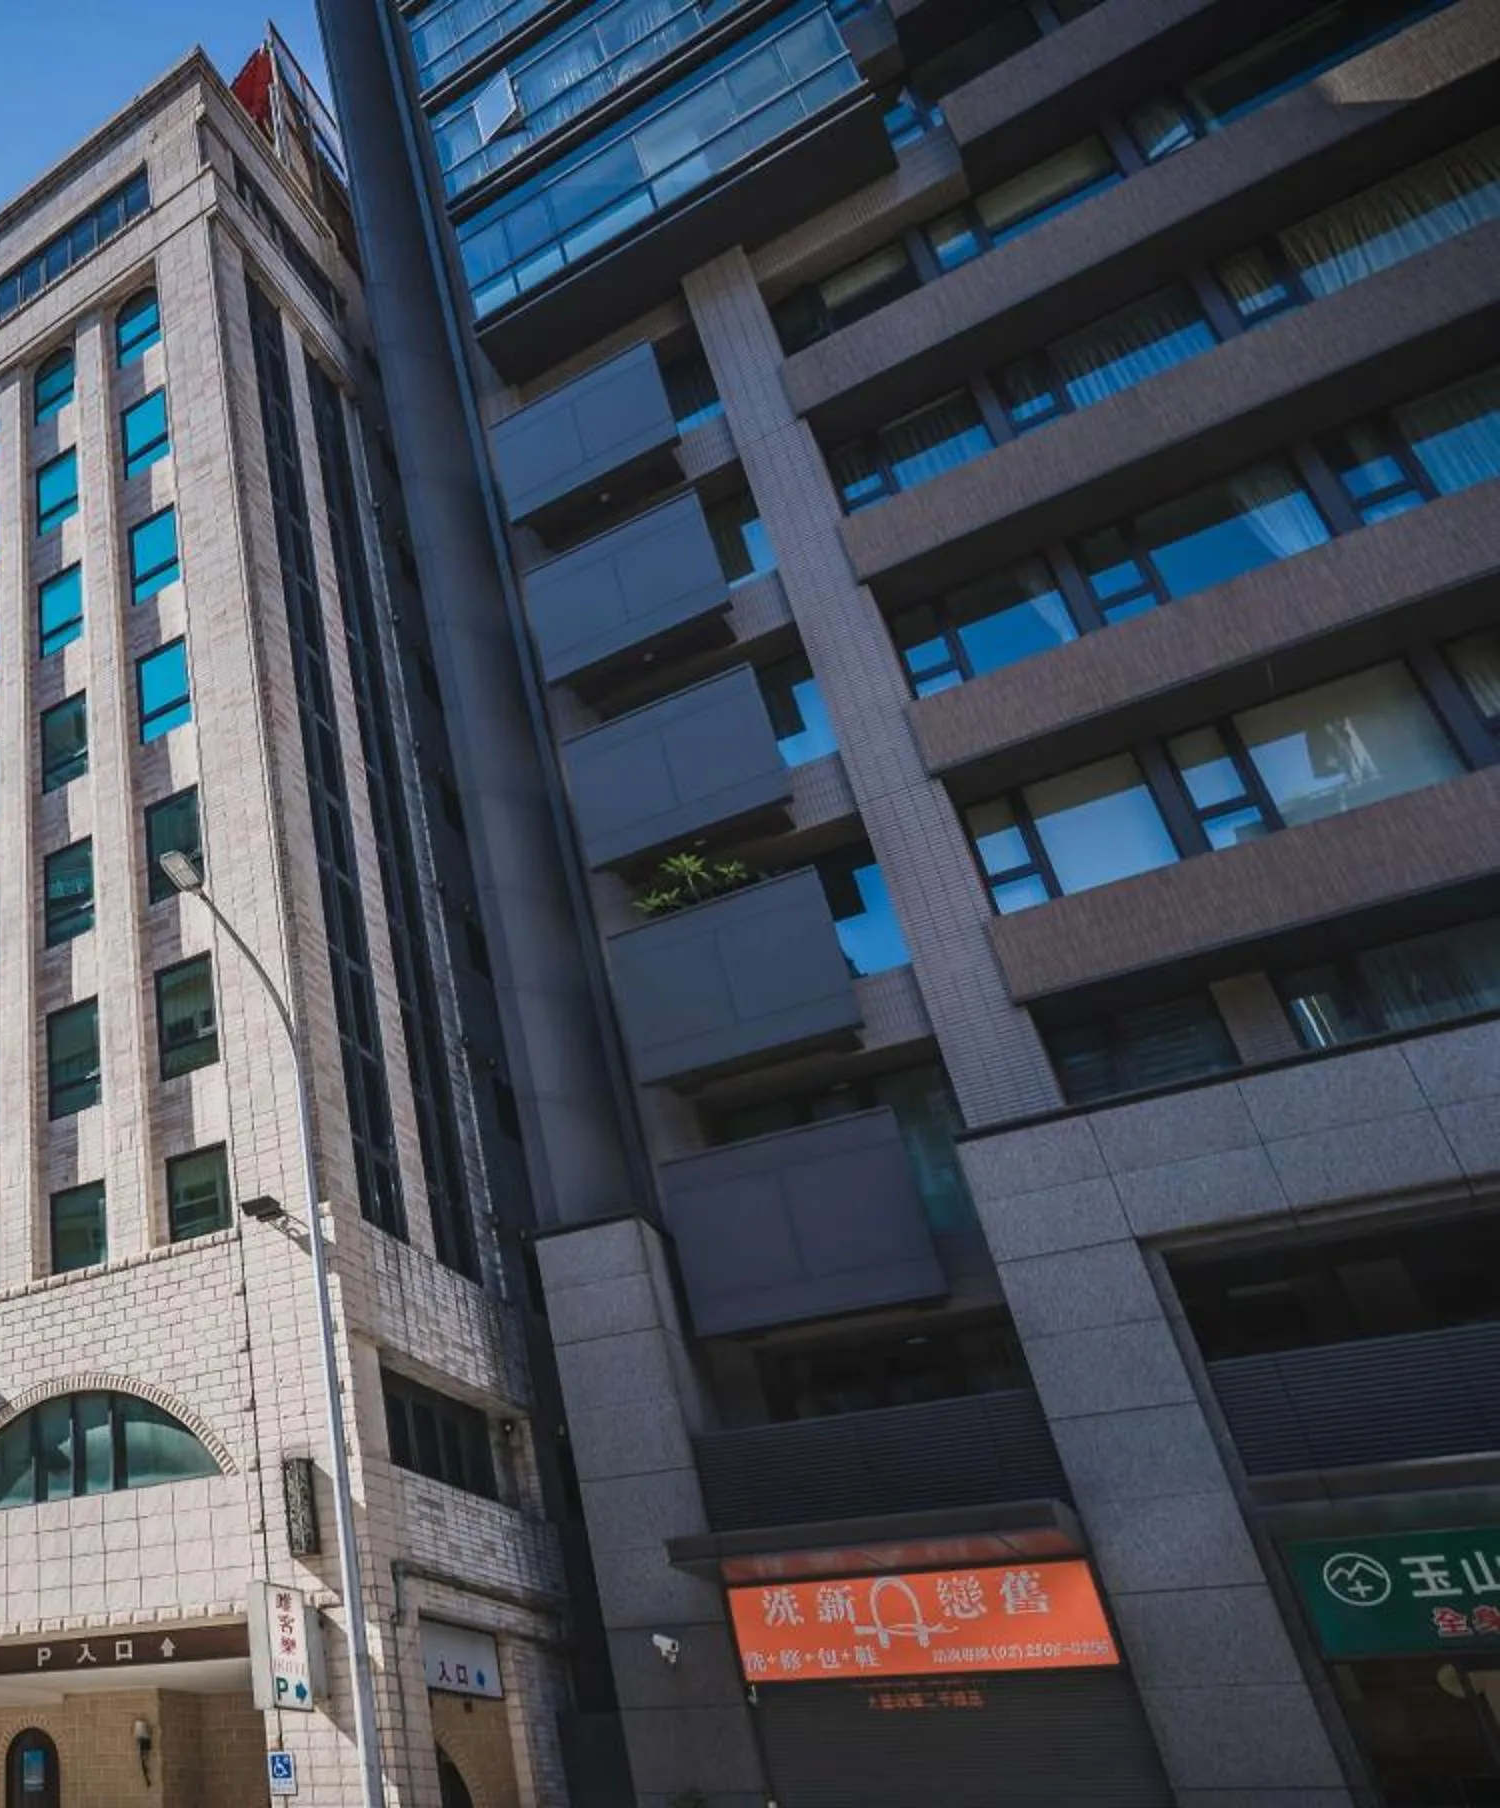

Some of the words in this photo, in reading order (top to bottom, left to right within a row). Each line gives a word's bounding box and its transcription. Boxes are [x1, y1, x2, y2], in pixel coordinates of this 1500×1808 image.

[761, 1585, 857, 1627] 洗新
[935, 1571, 1052, 1619] 戀舊
[37, 1647, 52, 1667] P
[77, 1641, 133, 1664] 入口
[439, 1660, 469, 1686] 入口
[276, 1677, 288, 1700] P
